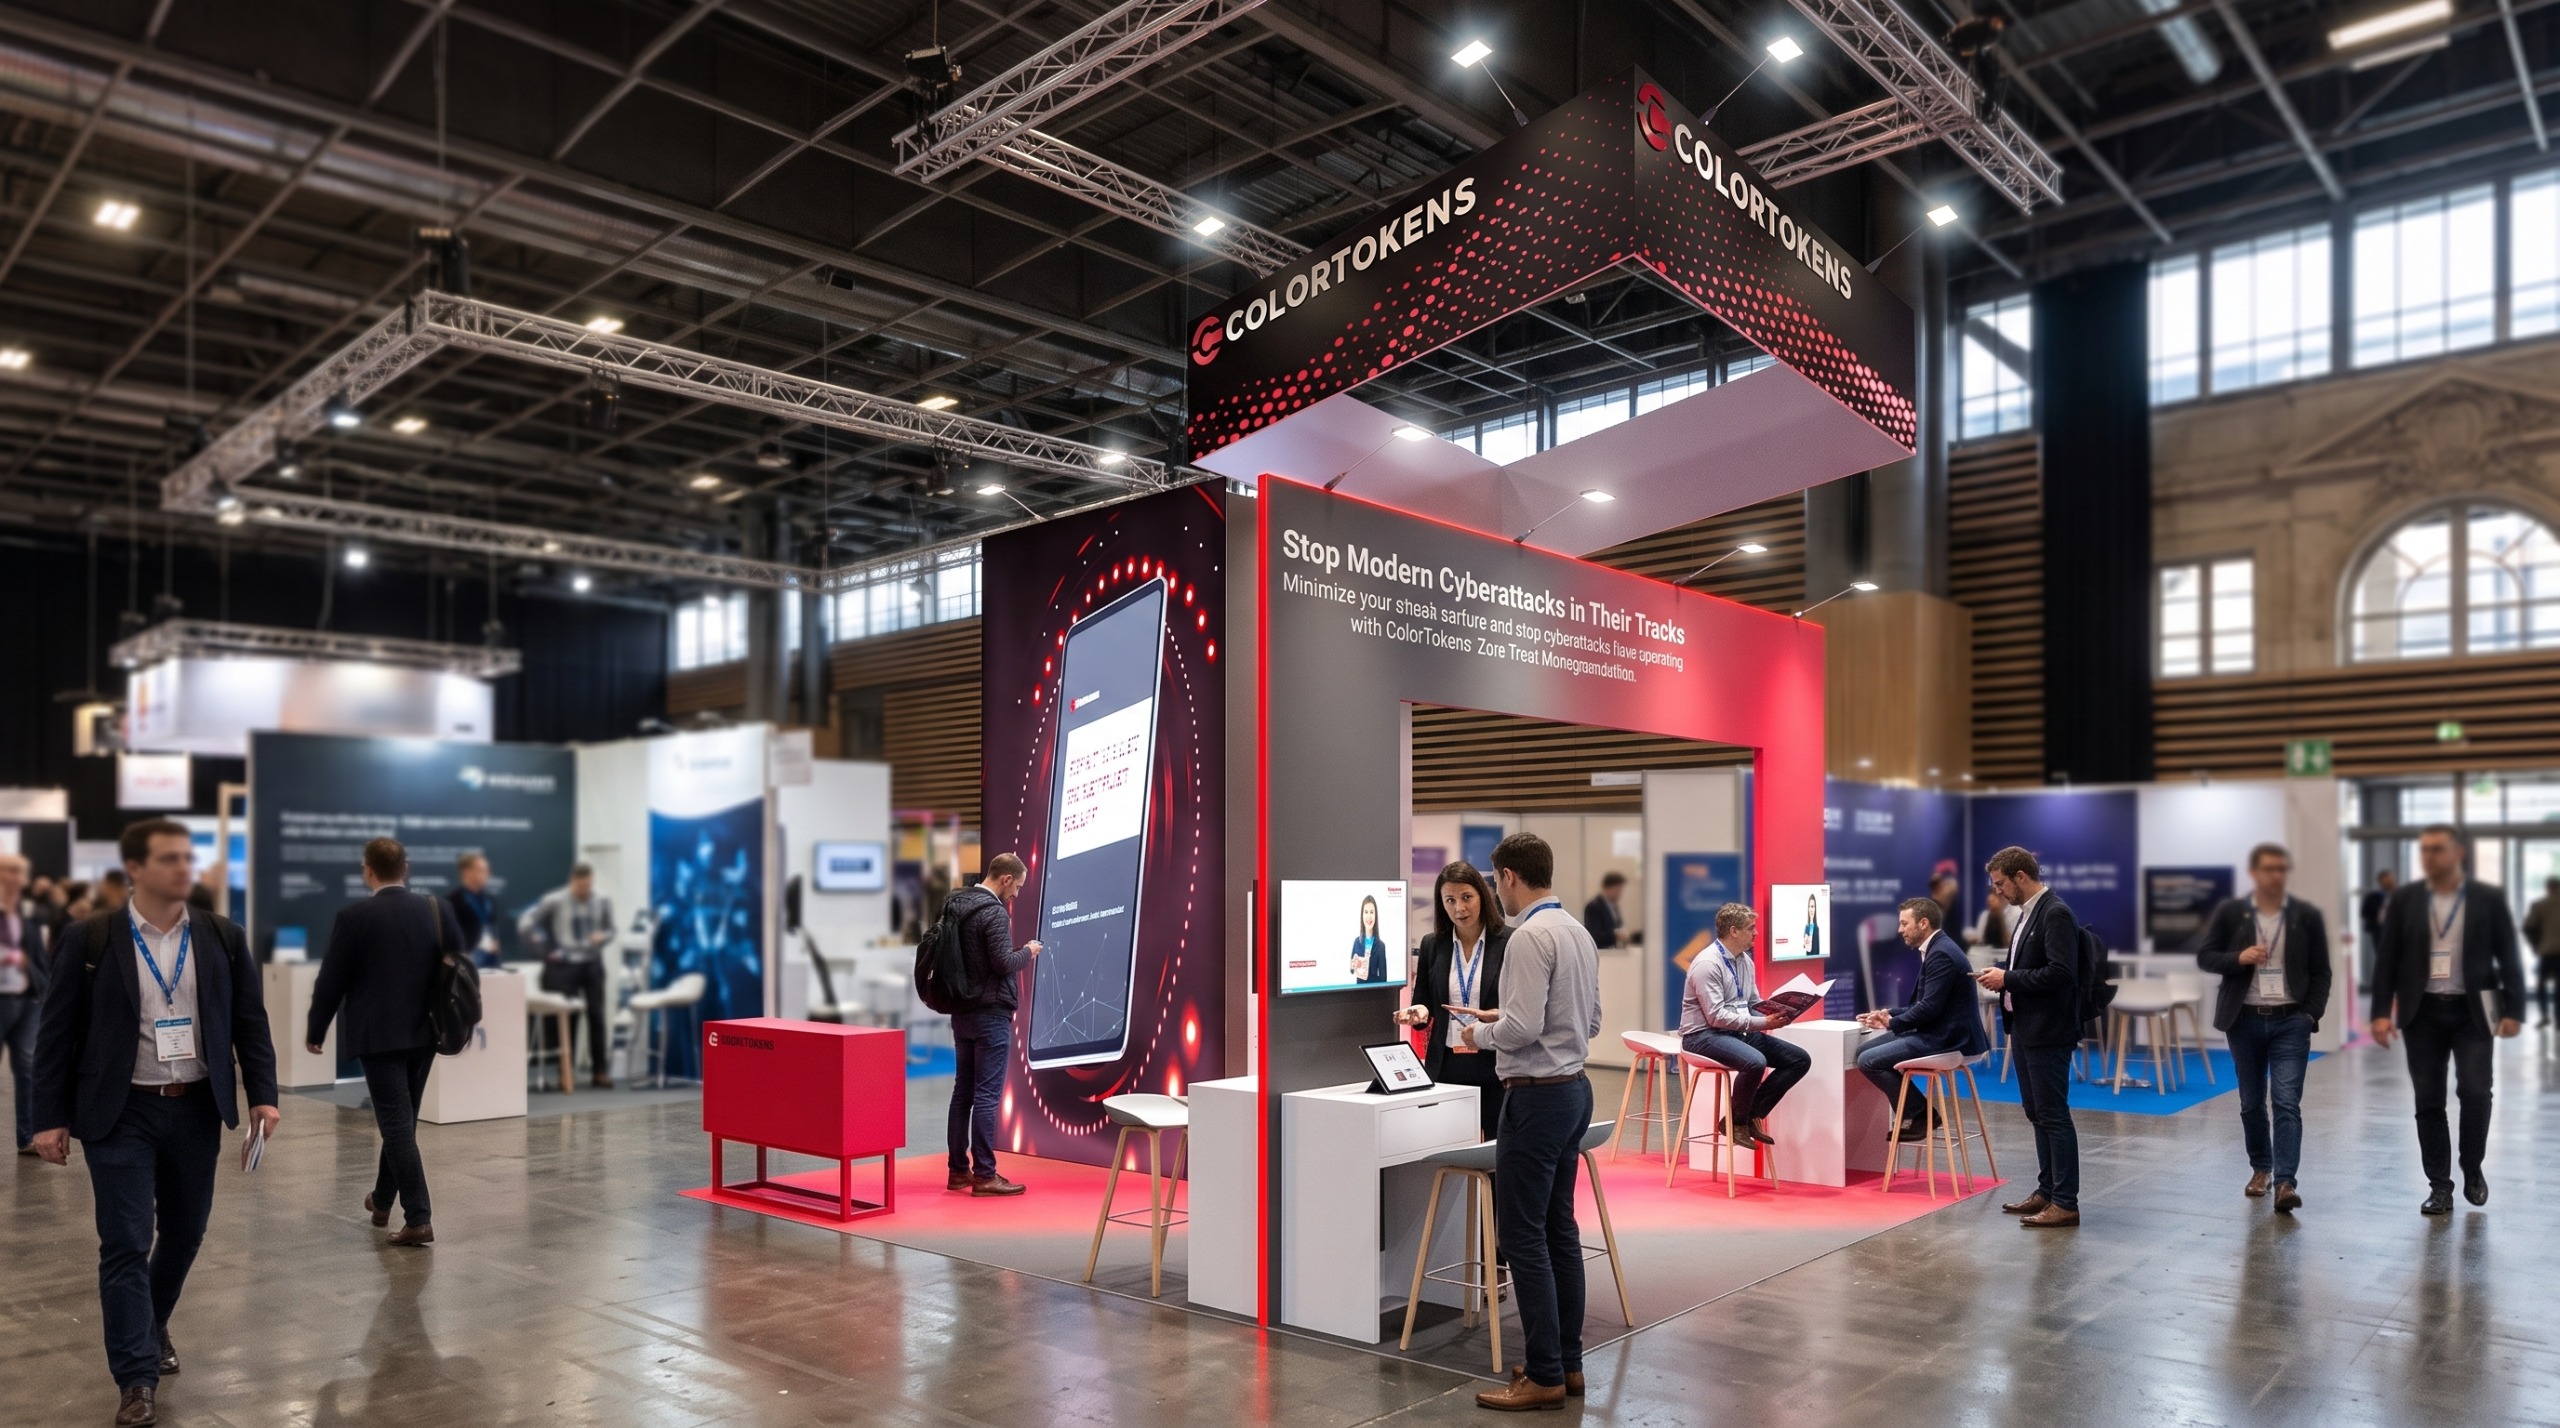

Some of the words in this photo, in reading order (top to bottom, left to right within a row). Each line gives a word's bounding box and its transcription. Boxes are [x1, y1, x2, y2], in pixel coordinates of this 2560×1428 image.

[1225, 177, 1477, 342] COLORTOKENS
[1674, 123, 1852, 300] COLORTOKENS
[1282, 529, 1341, 575] Stop
[1347, 543, 1434, 589] Modern
[1439, 566, 1566, 618] Cyberattacks
[1570, 596, 1586, 623] in
[1589, 600, 1632, 633] Their
[1635, 611, 1686, 645] Tracks
[1283, 571, 1356, 604] Minimize
[1359, 591, 1393, 612] your
[1490, 618, 1513, 636] and
[1515, 622, 1542, 645] stop
[1543, 628, 1611, 655] cyberattacks
[1350, 616, 1382, 637] with
[1386, 620, 1472, 653] ColorTokens
[1477, 637, 1506, 659] Zore
[1508, 643, 1539, 665] Treat
